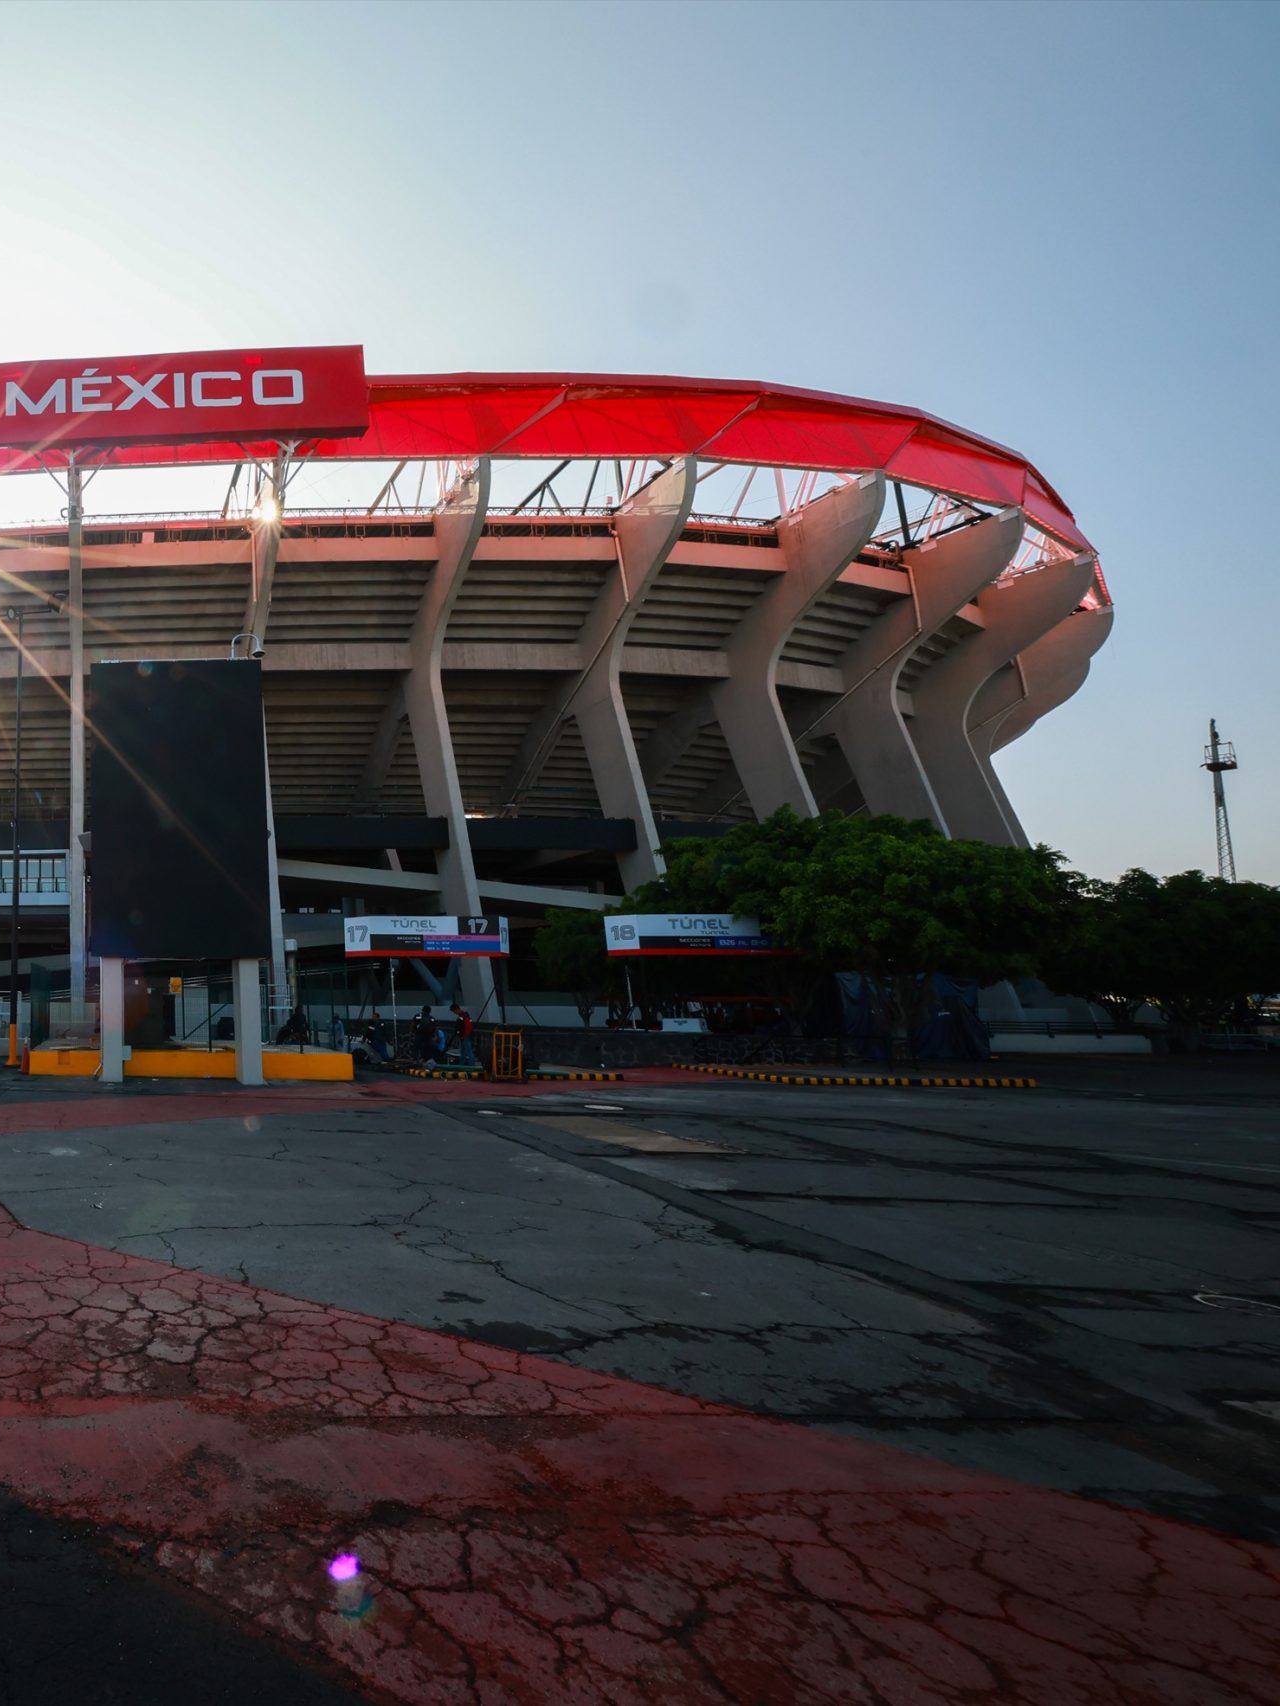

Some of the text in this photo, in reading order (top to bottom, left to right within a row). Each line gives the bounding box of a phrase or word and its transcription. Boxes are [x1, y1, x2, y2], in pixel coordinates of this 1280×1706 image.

[5, 367, 304, 418] MÉXICO
[390, 918, 437, 929] TÚNEL
[467, 918, 488, 934] 17
[668, 916, 730, 930] TÚNEL
[346, 925, 369, 943] 17
[610, 924, 636, 941] 18
